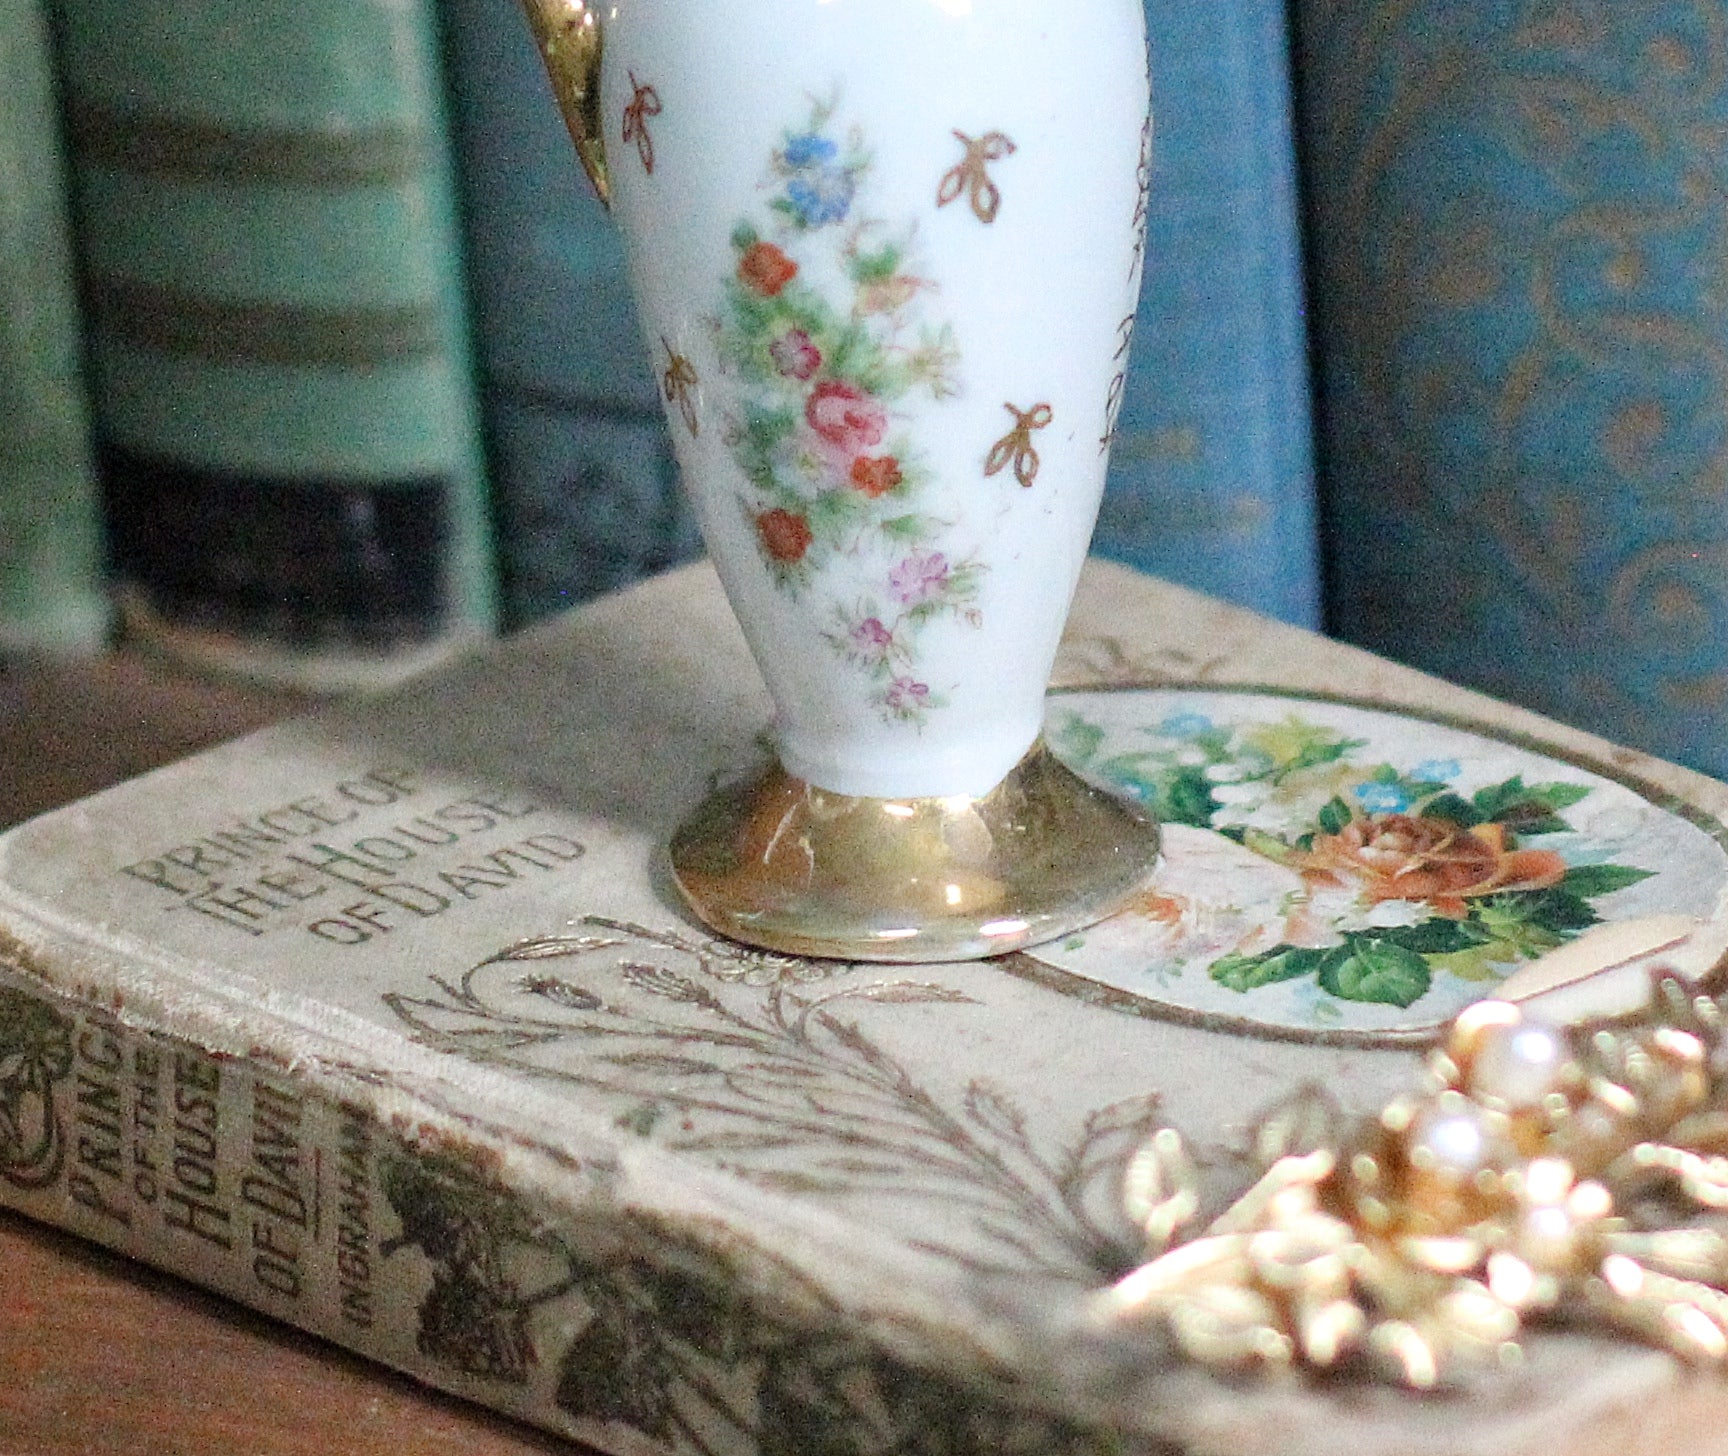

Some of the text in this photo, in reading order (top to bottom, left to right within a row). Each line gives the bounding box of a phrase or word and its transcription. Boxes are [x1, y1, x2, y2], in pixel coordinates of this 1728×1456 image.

[121, 765, 422, 895] PRINCE OF
[166, 795, 536, 937] THE HOUSE
[308, 832, 588, 945] OF DAVID
[134, 1048, 160, 1205] OF THE
[164, 1049, 233, 1251] HOUSE
[252, 1220, 301, 1299] OF
